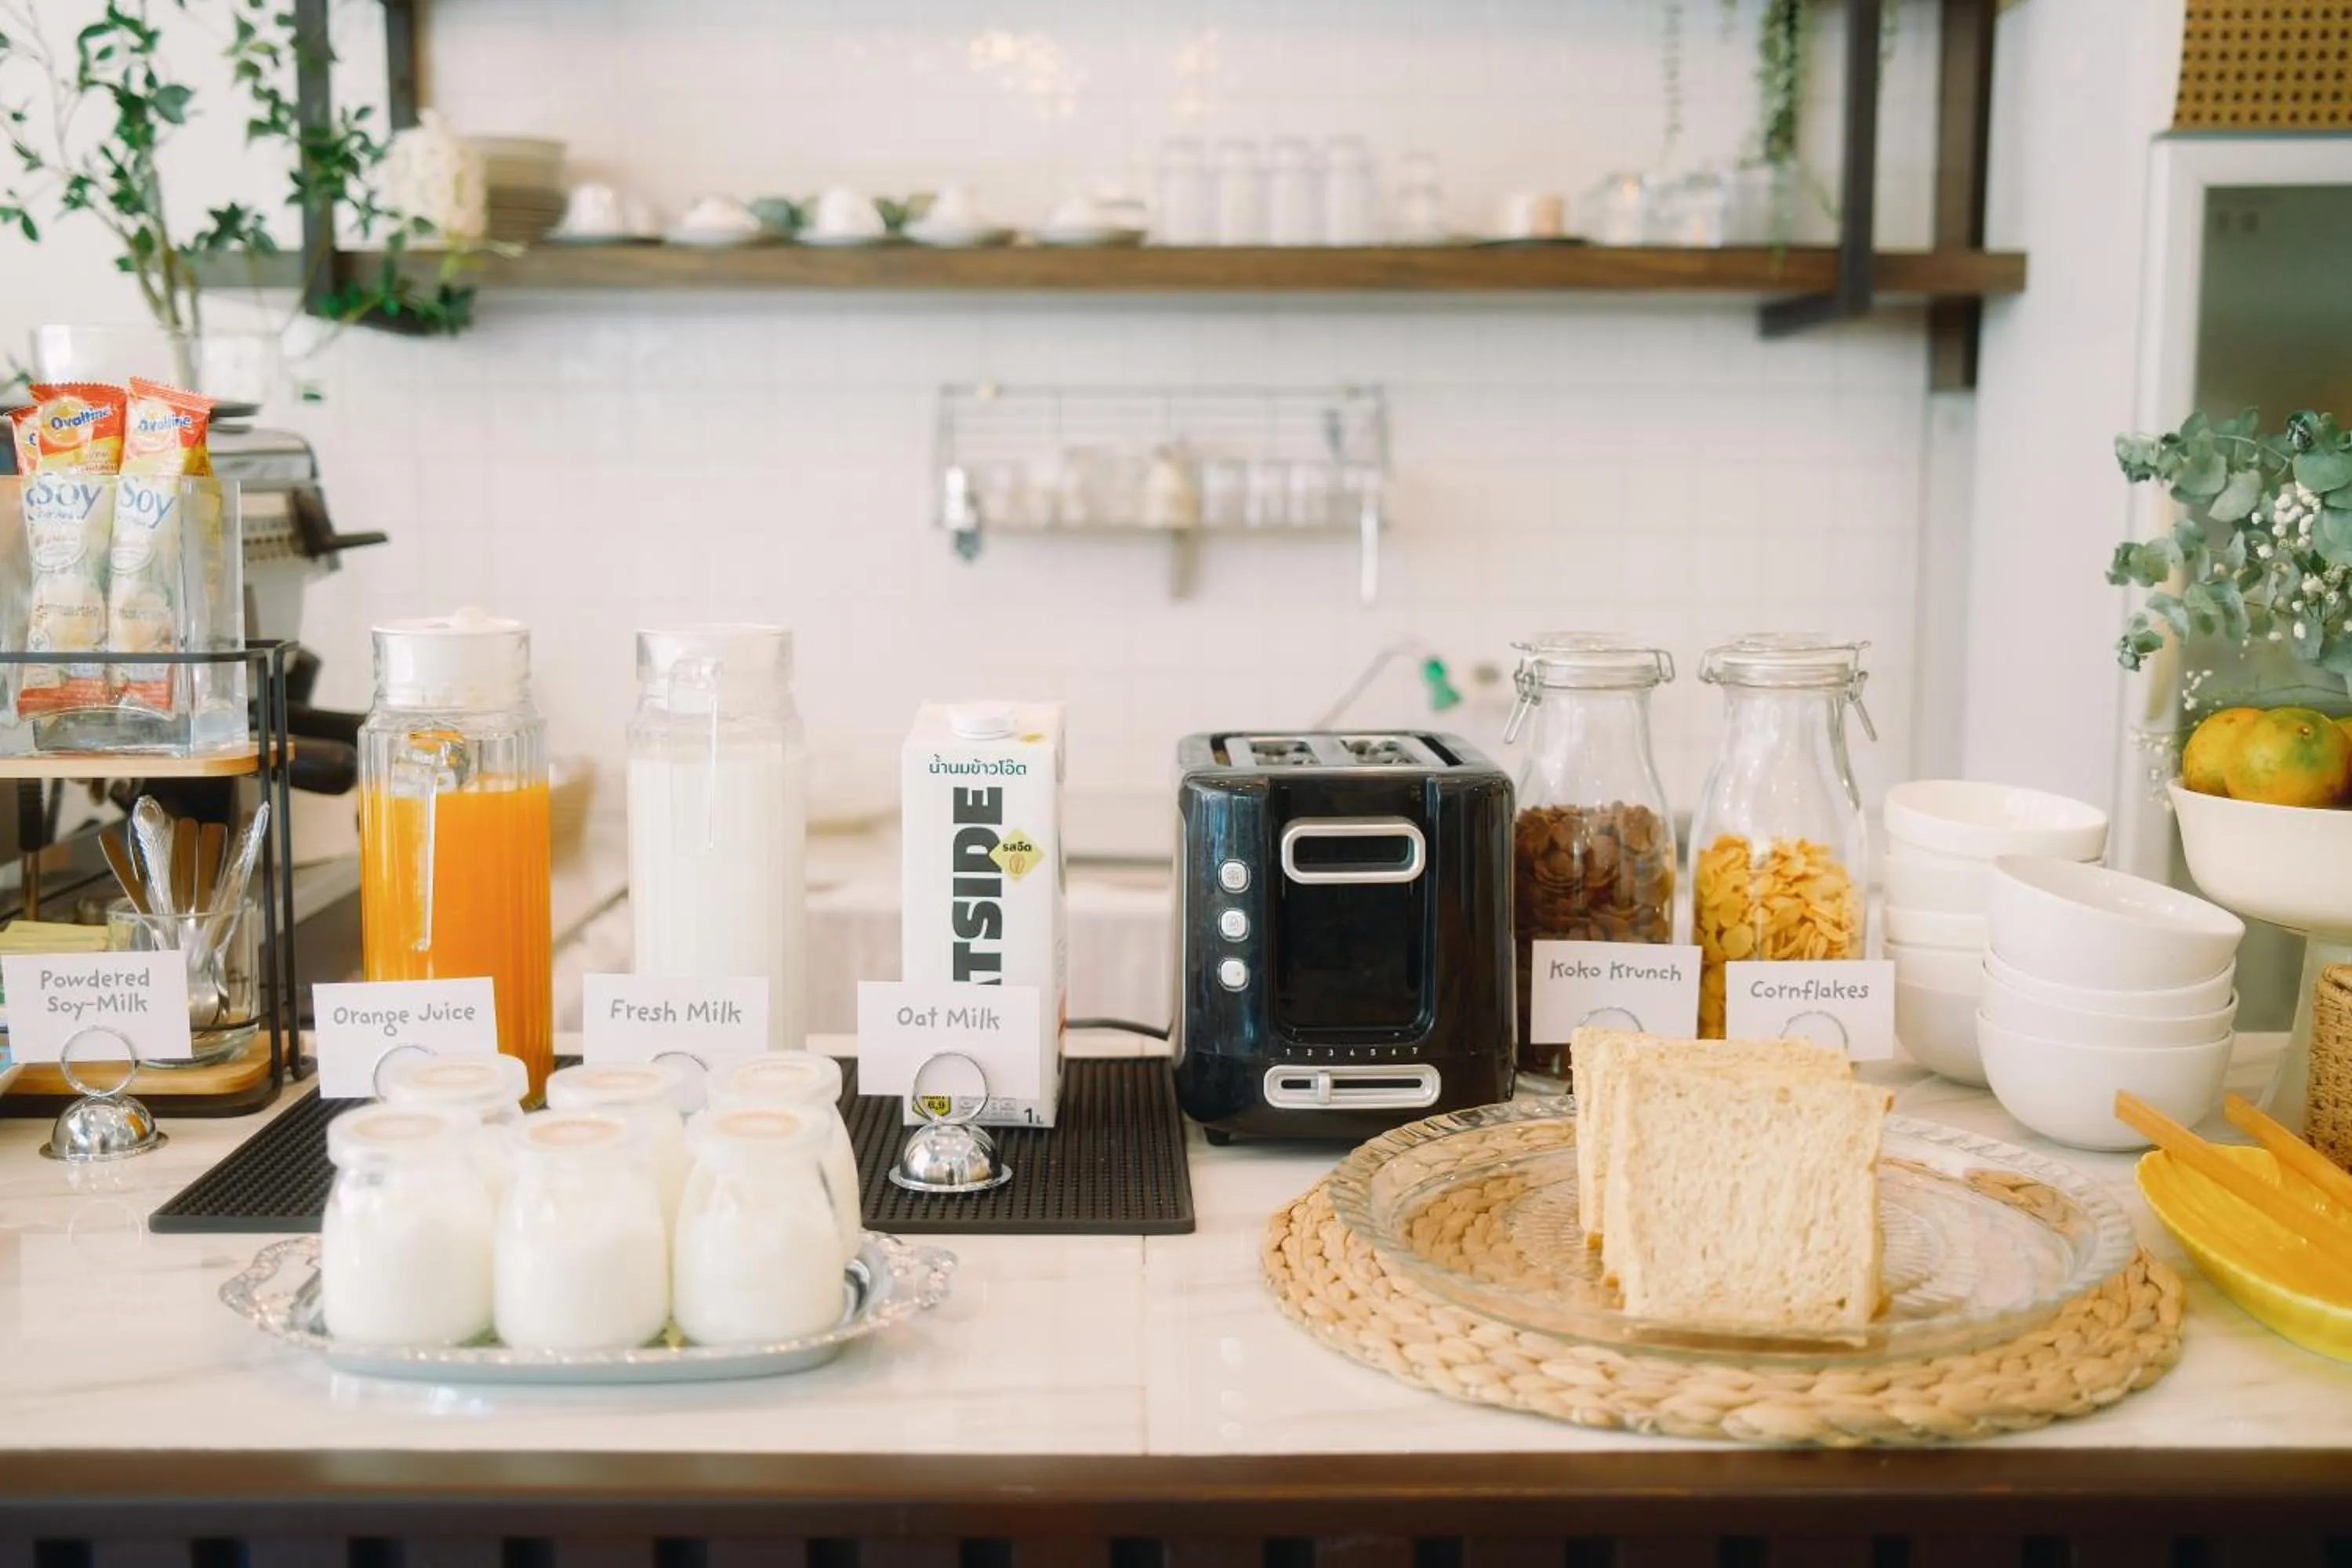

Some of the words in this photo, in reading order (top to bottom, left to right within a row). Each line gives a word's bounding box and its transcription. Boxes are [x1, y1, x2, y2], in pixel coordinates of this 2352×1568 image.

[26, 472, 103, 520] Soy
[120, 475, 176, 529] Soy
[953, 786, 1003, 985] TSIDE
[40, 967, 151, 990] Powdered
[1549, 960, 1601, 979] Koko
[1610, 961, 1682, 982] Krunch
[1750, 979, 1870, 1000] Cornflakes
[47, 993, 147, 1021] Soy-Milk
[333, 1007, 410, 1036] Orange
[418, 1002, 476, 1021] Juice
[611, 999, 677, 1022] Fresh
[687, 1000, 742, 1024] Milk
[897, 1007, 938, 1029] Oat
[946, 1007, 1000, 1030] Milk
[1024, 1108, 1033, 1123] 1
